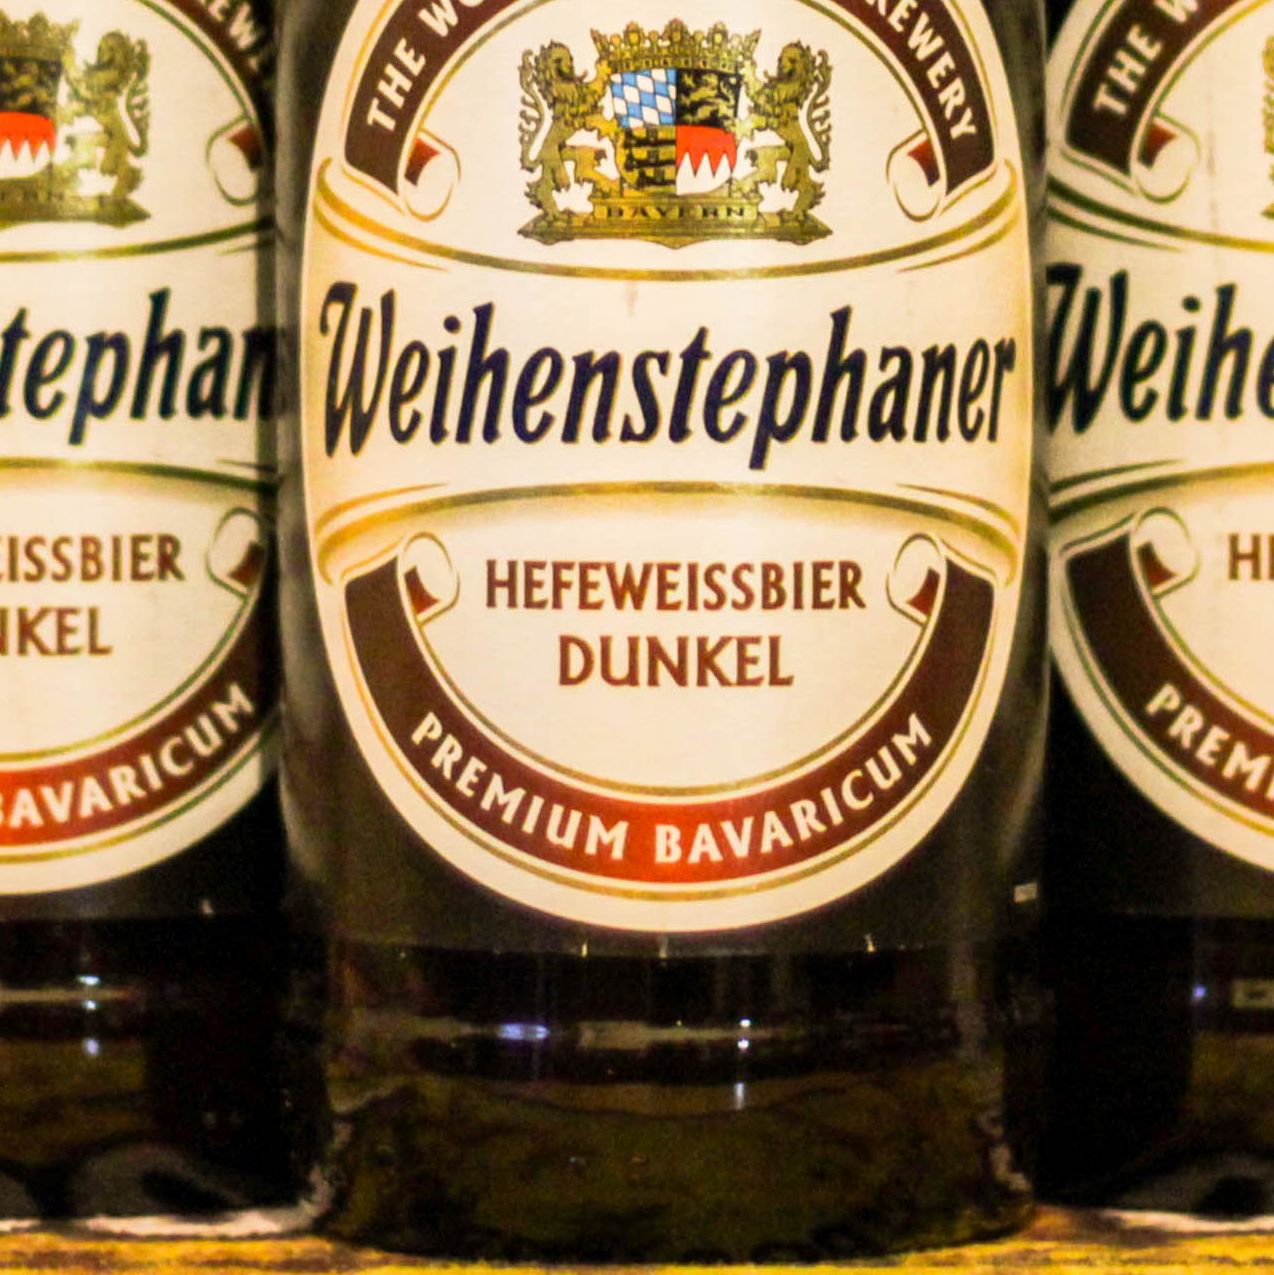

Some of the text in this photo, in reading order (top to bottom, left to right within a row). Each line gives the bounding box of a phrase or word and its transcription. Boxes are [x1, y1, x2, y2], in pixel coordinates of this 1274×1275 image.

[366, 38, 426, 132] THE
[1093, 26, 1164, 118] THE
[319, 281, 1015, 470] Weihenstephaner
[485, 558, 866, 610] HEFEWEISSBIER
[558, 635, 794, 687] DUNKEL
[411, 713, 932, 865] PREMIUM BAVARICUM
